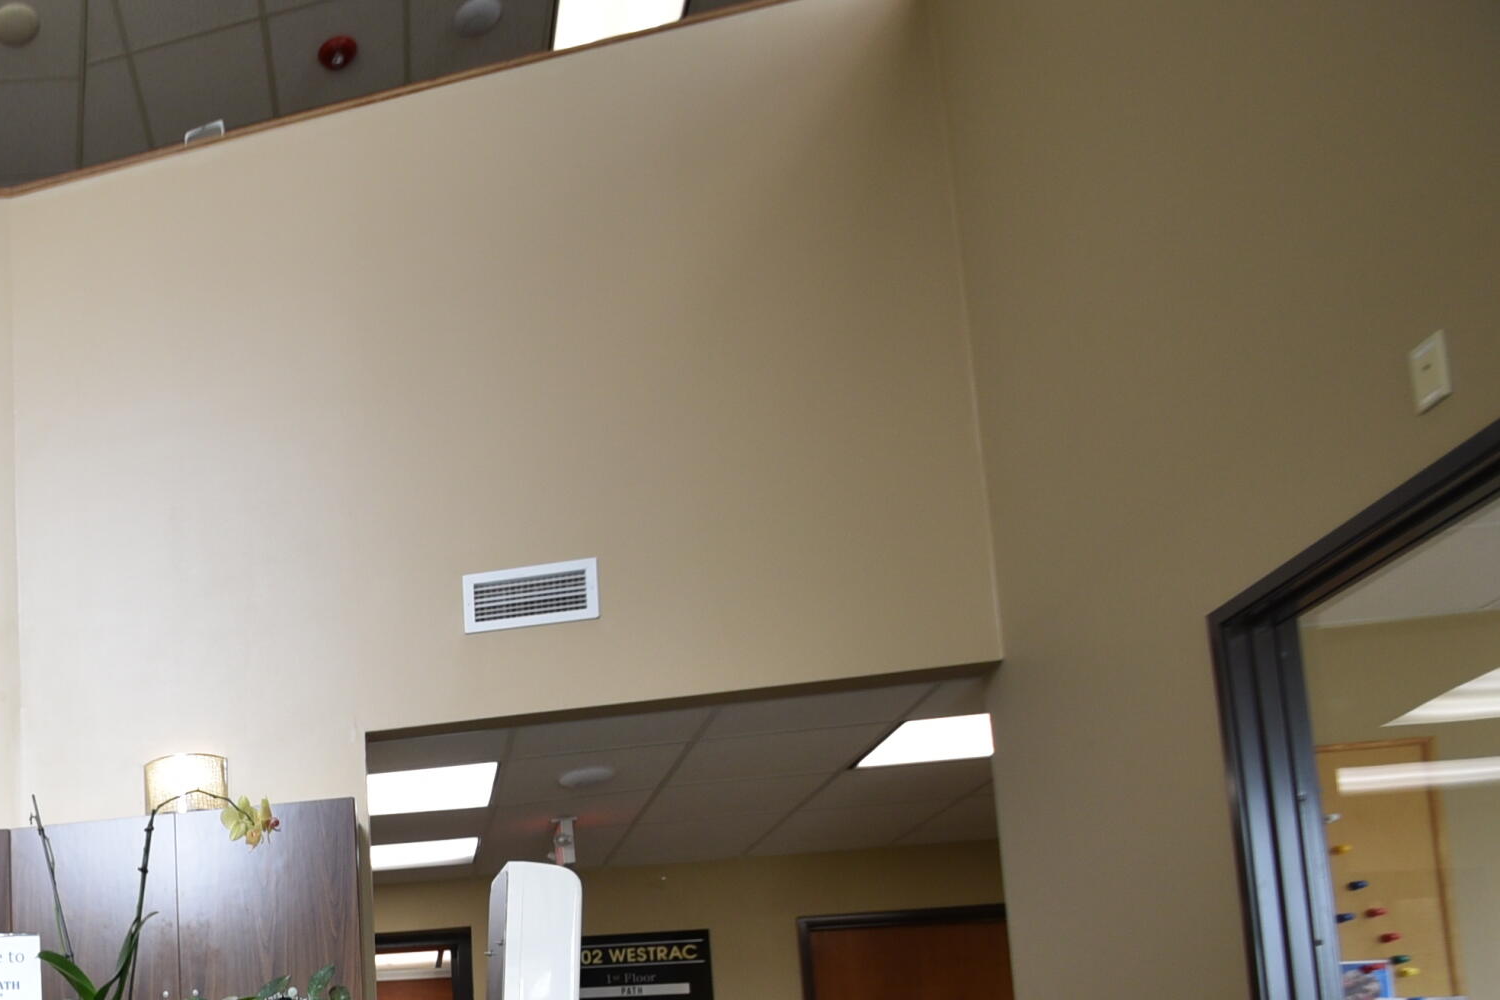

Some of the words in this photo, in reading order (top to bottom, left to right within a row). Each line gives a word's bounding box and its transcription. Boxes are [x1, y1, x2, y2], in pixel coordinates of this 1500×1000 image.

[8, 951, 25, 964] to
[581, 949, 603, 965] 02
[609, 944, 698, 963] WESTRAC
[624, 972, 657, 984] Floor
[621, 986, 643, 996] PATH
